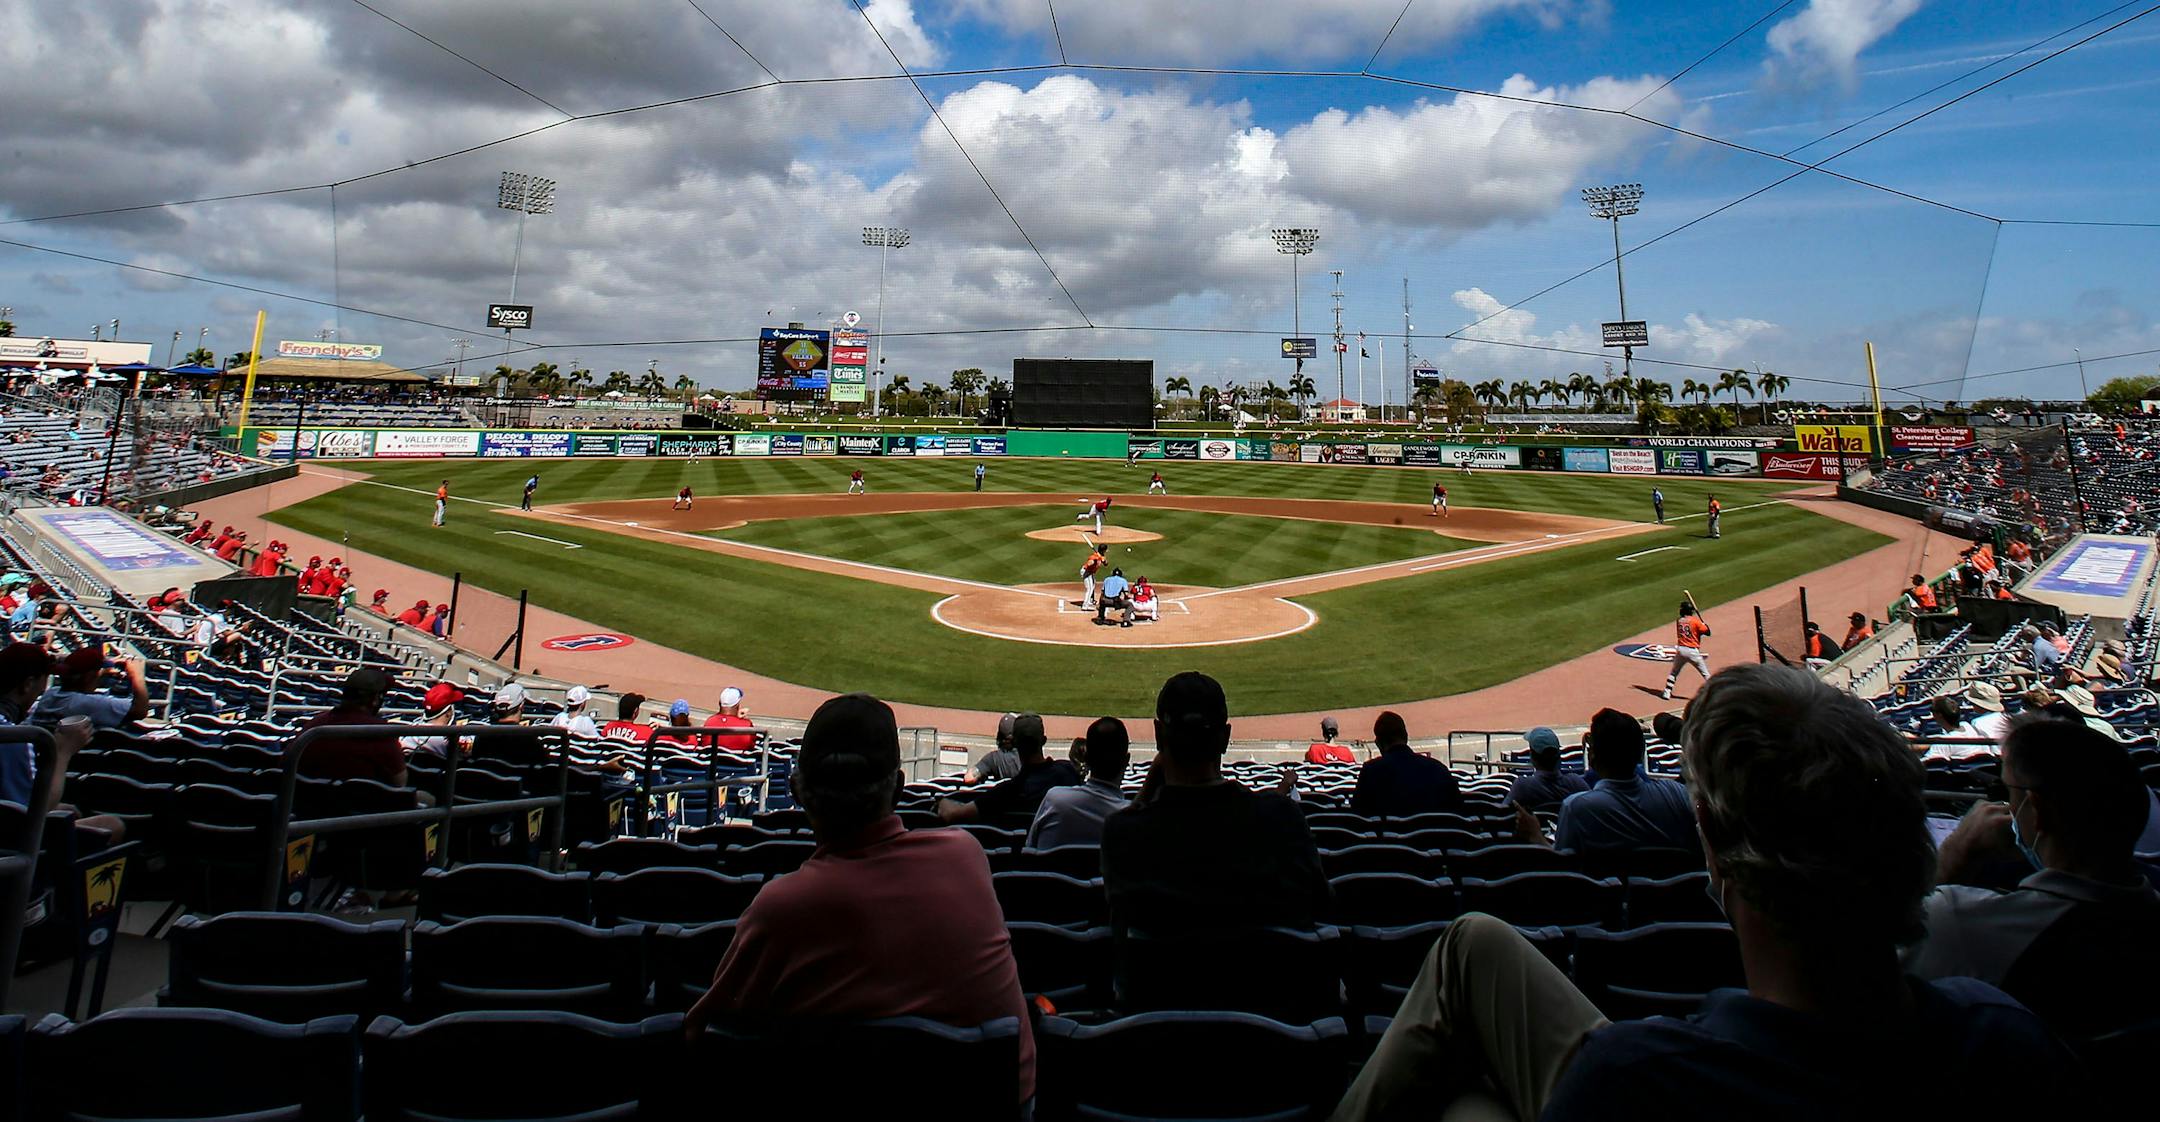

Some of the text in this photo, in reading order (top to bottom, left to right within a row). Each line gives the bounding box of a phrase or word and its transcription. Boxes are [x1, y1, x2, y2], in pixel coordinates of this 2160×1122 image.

[491, 306, 528, 322] Sysco
[283, 342, 363, 357] Frenchy's
[834, 368, 863, 379] Times
[322, 431, 360, 447] Abe's
[405, 435, 468, 444] VALLEY FORGE
[1648, 438, 1752, 447] WORLD CHAMPIONS
[1801, 433, 1863, 450] Wawa
[1935, 434, 1966, 442] Campus
[662, 440, 718, 449] SHEPHARD'S
[1821, 457, 1839, 466] THIS
[1822, 466, 1840, 475] FOR
